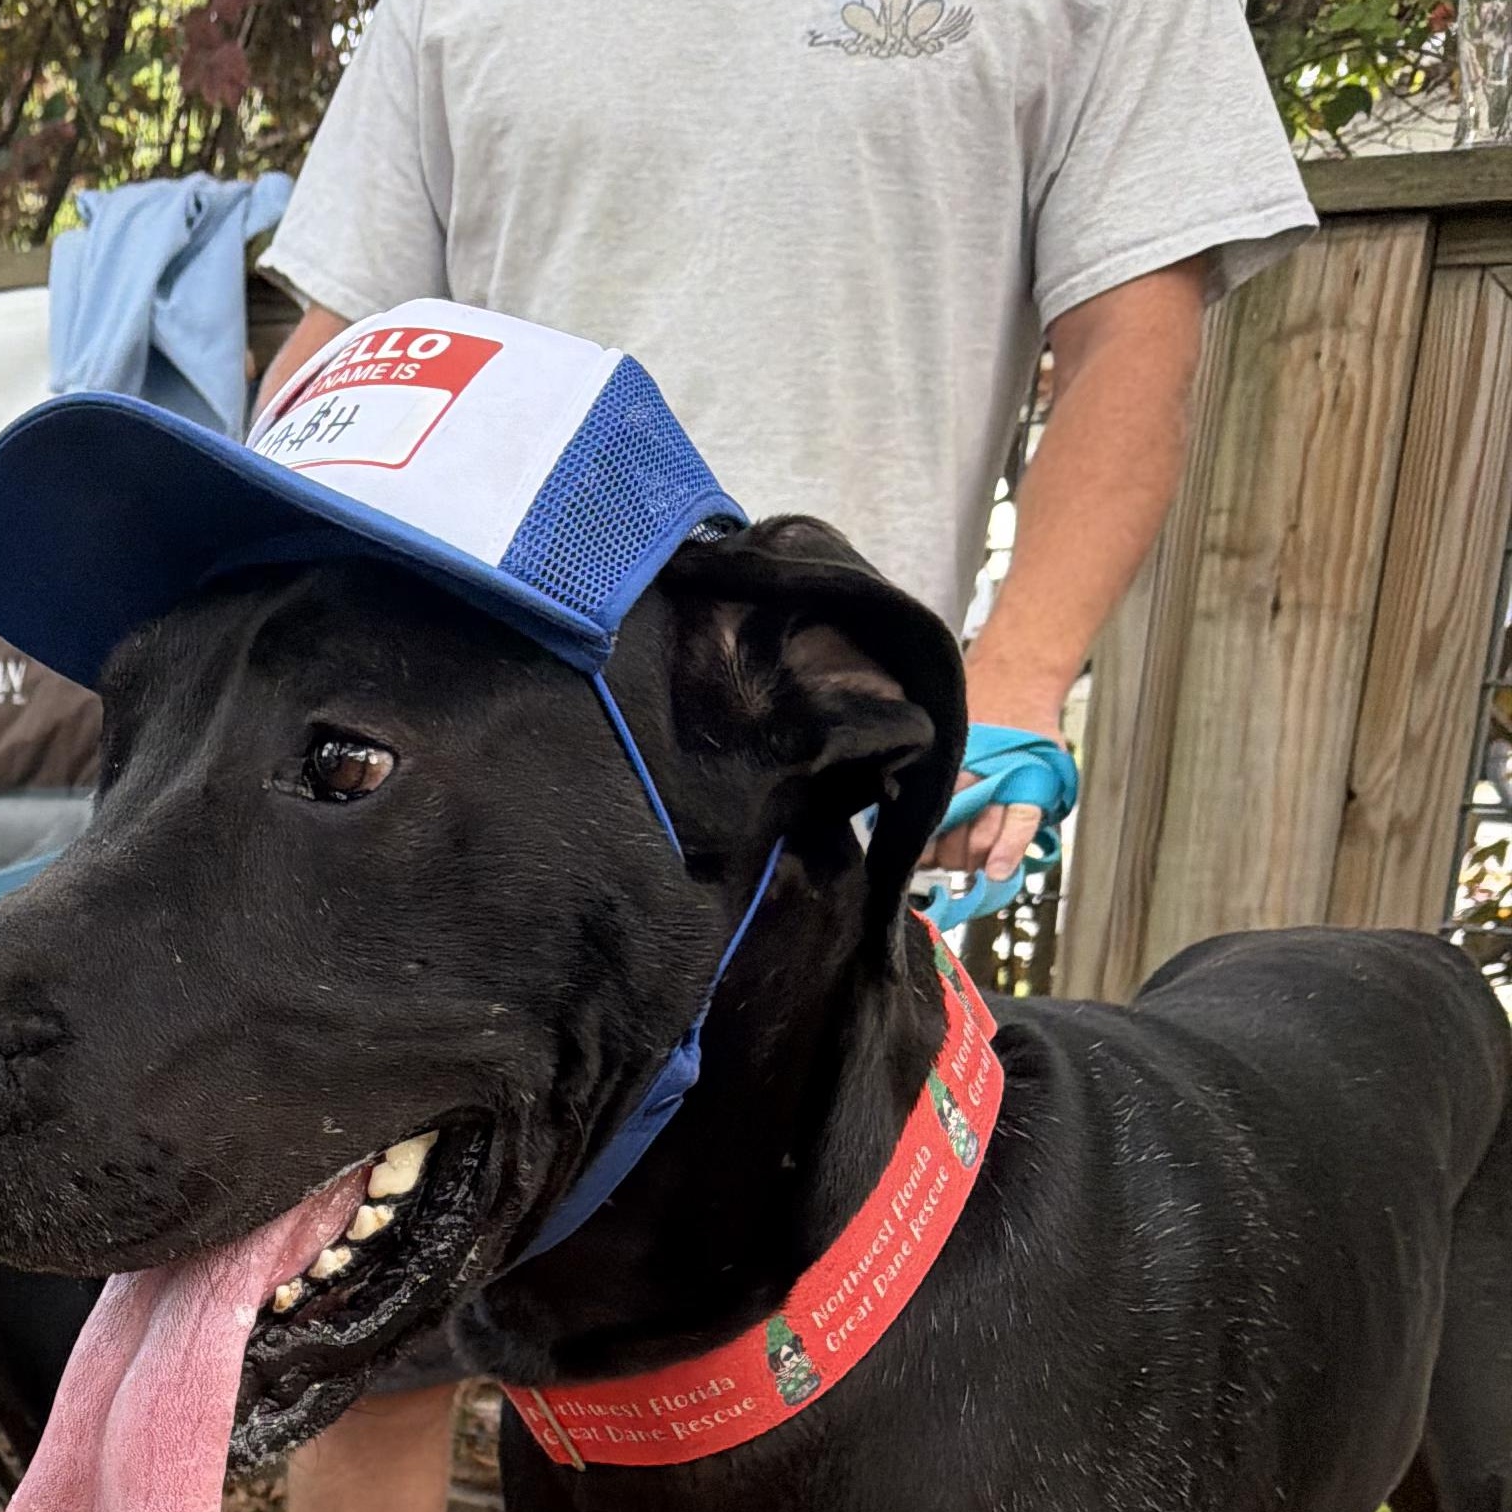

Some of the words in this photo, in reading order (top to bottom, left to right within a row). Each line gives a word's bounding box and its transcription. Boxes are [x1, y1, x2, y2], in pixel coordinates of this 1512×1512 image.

[324, 330, 452, 375] ELLO
[318, 362, 392, 393] NAME
[388, 362, 422, 380] IS
[810, 1218, 896, 1330] Northwest
[890, 1144, 933, 1223] Florida
[825, 1294, 876, 1354] Great
[872, 1240, 913, 1300] Dane
[908, 1164, 950, 1236] Rescue
[604, 1424, 667, 1444] Dane
[669, 1395, 757, 1441] Rescue
[648, 1376, 737, 1417] Florida
